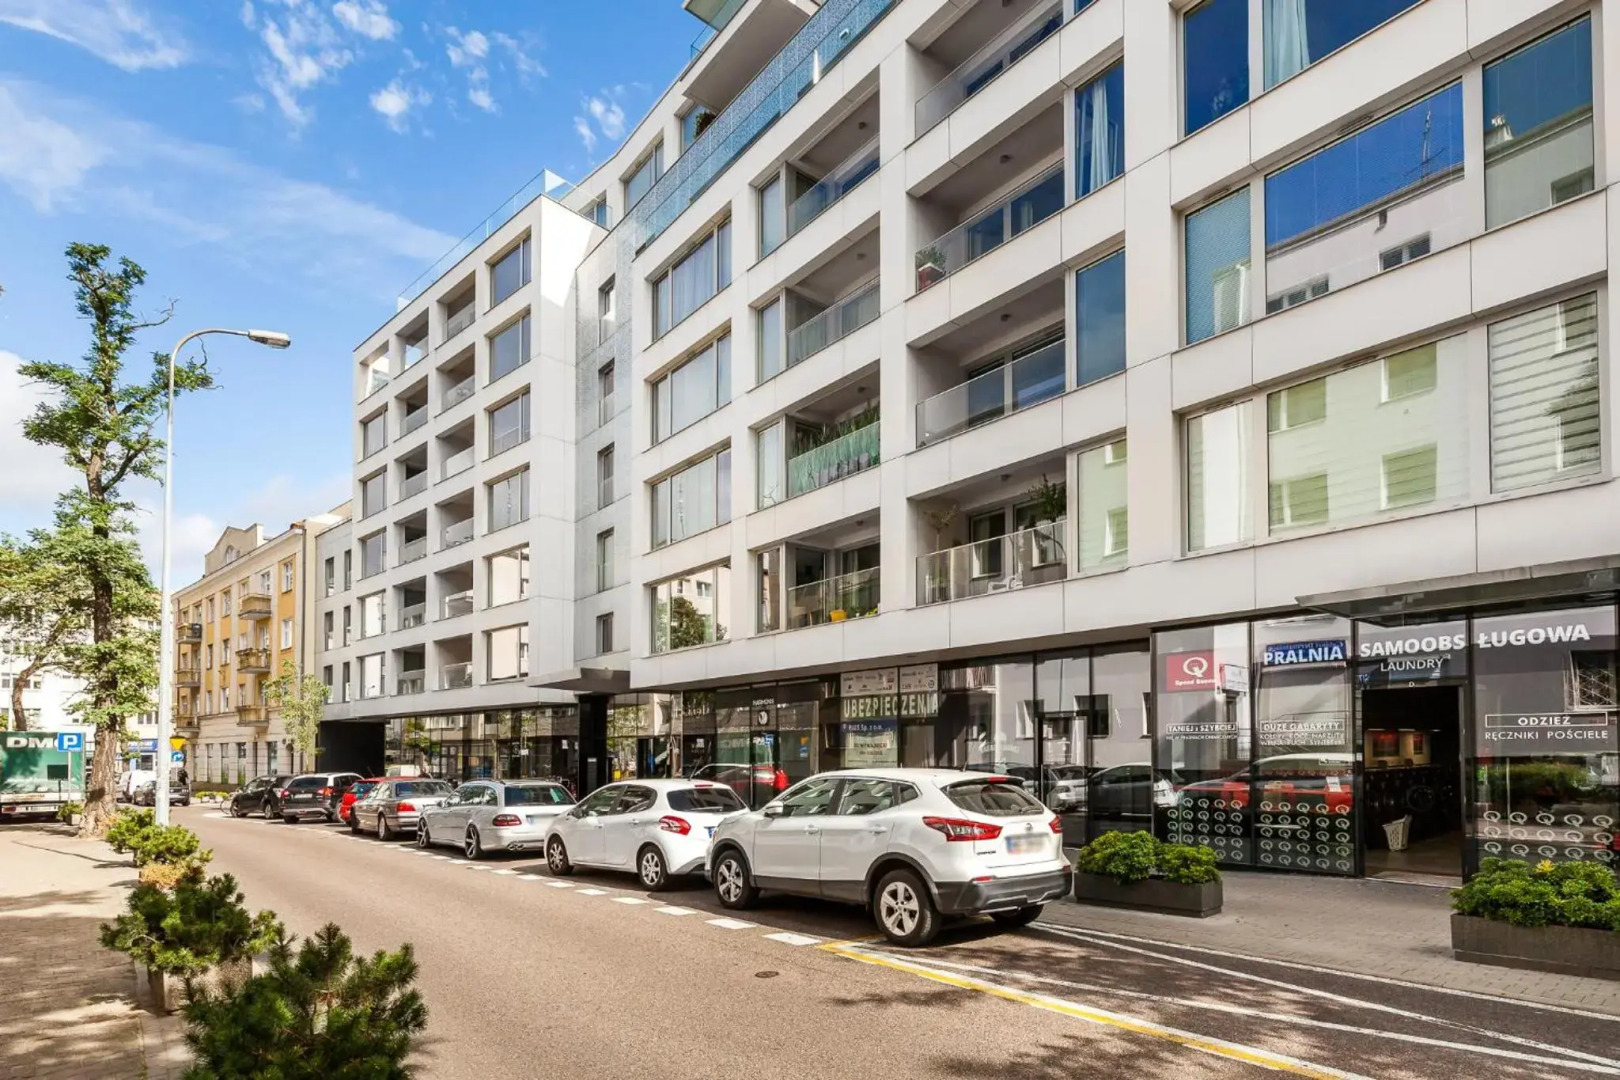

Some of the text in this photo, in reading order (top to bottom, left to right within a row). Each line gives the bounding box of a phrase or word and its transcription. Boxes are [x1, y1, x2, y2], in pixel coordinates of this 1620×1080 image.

[1360, 624, 1591, 658] SAMOOBS ŁUGOWA
[1263, 646, 1344, 666] PRALNIA
[1380, 657, 1444, 672] LAUNDRY
[843, 692, 939, 719] UBEZPIECZENIA
[1517, 715, 1571, 726] ODZIEŻ
[63, 735, 78, 749] P
[1485, 729, 1609, 741] RĘCZNIKI POŚCIELE
[6, 737, 58, 749] DM
